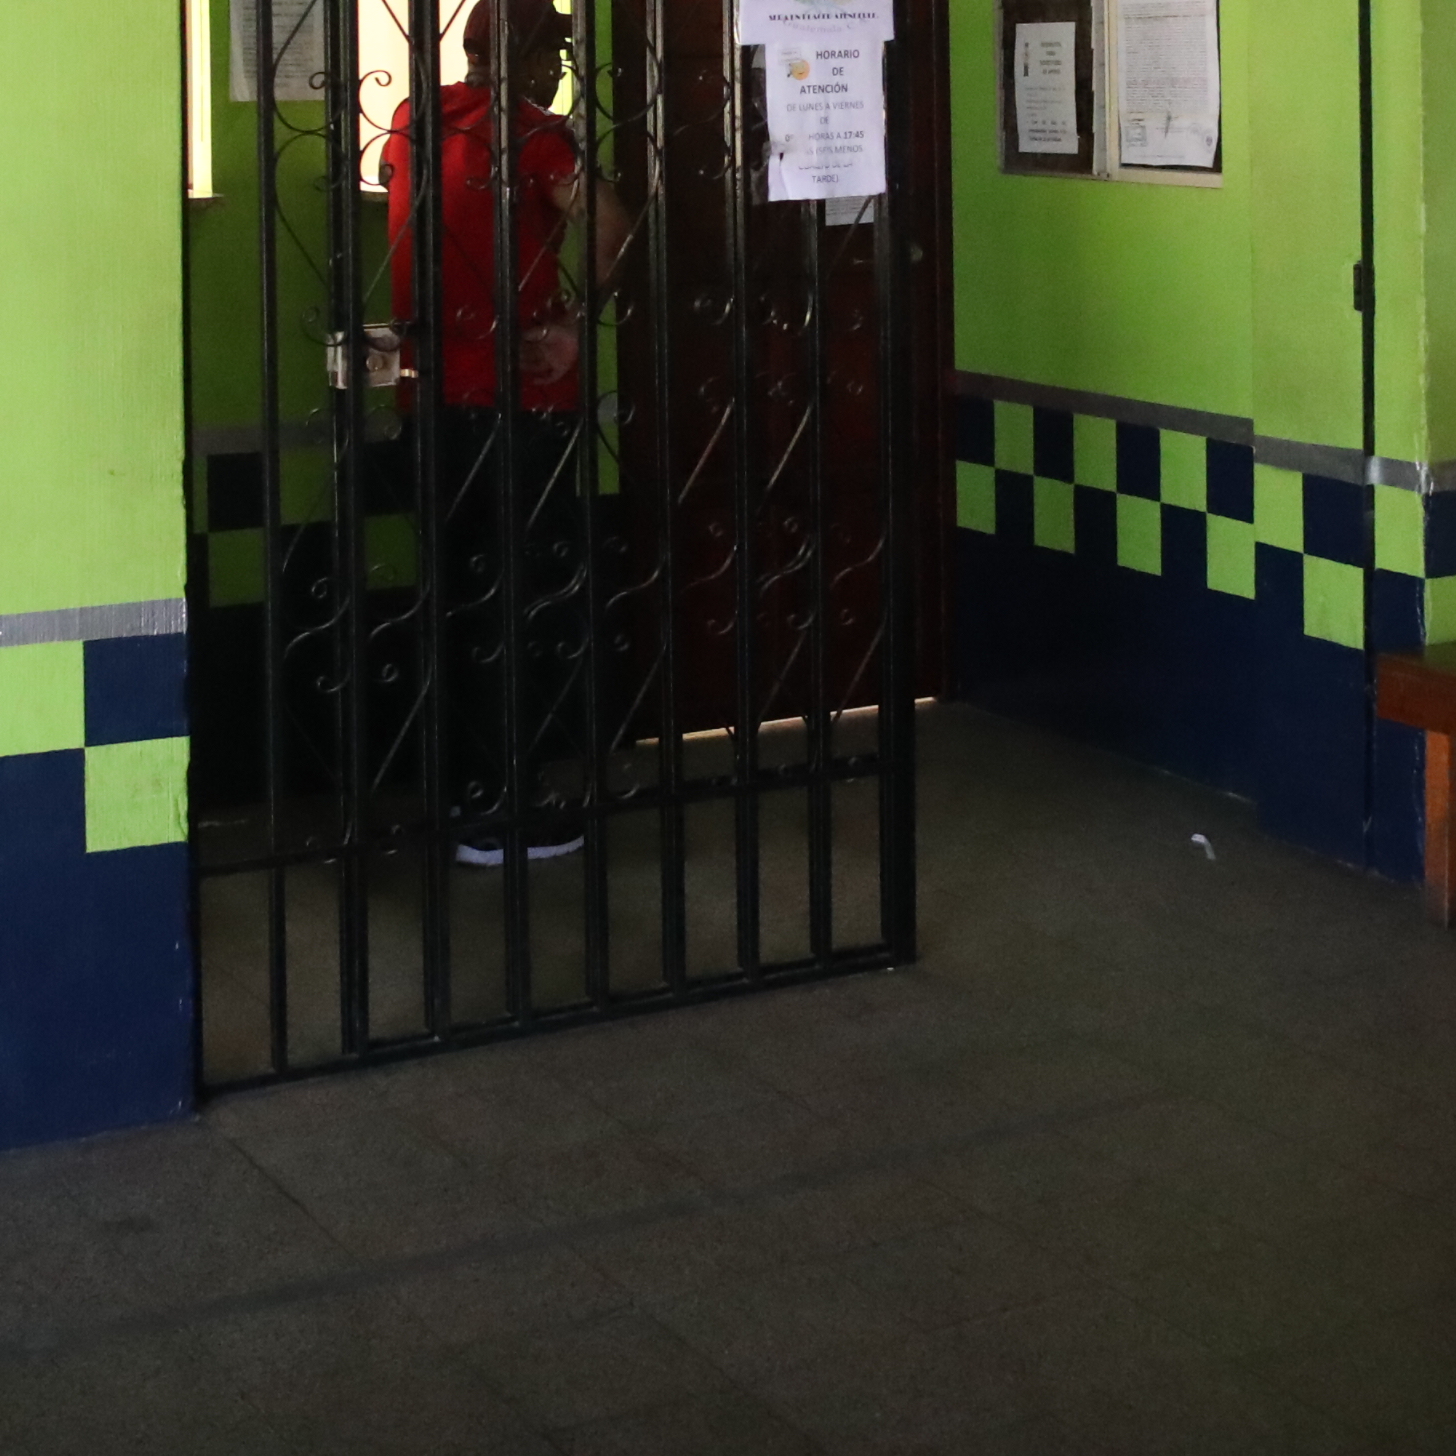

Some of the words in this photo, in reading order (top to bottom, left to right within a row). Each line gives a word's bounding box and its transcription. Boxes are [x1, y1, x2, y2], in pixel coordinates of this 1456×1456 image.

[816, 49, 860, 60] HORARIO
[832, 67, 844, 76] DE
[800, 83, 848, 94] ATENCIÓN
[786, 102, 796, 112] DE
[799, 101, 823, 111] LUNES
[825, 101, 831, 110] A
[833, 100, 864, 110] VIERNES
[819, 116, 829, 125] DE
[809, 130, 834, 140] HORAS
[836, 130, 842, 139] A
[844, 130, 864, 140] 17:45
